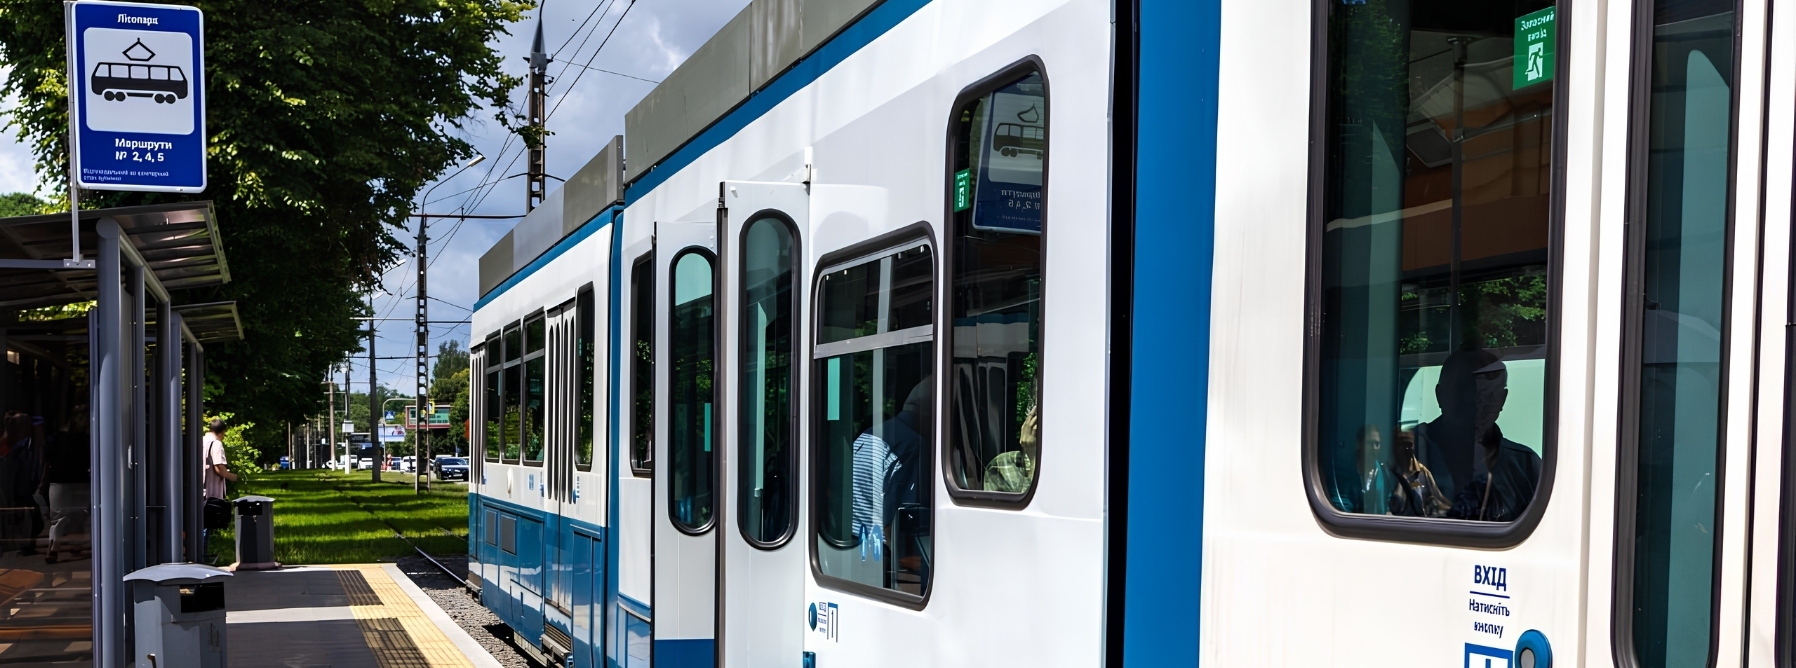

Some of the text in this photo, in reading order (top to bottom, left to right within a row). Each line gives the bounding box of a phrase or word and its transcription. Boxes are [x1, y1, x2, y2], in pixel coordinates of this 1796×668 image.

[115, 138, 172, 151] Маршрути
[157, 152, 165, 162] 5
[1474, 564, 1507, 592] ВХІД
[1468, 598, 1511, 617] Натисніть
